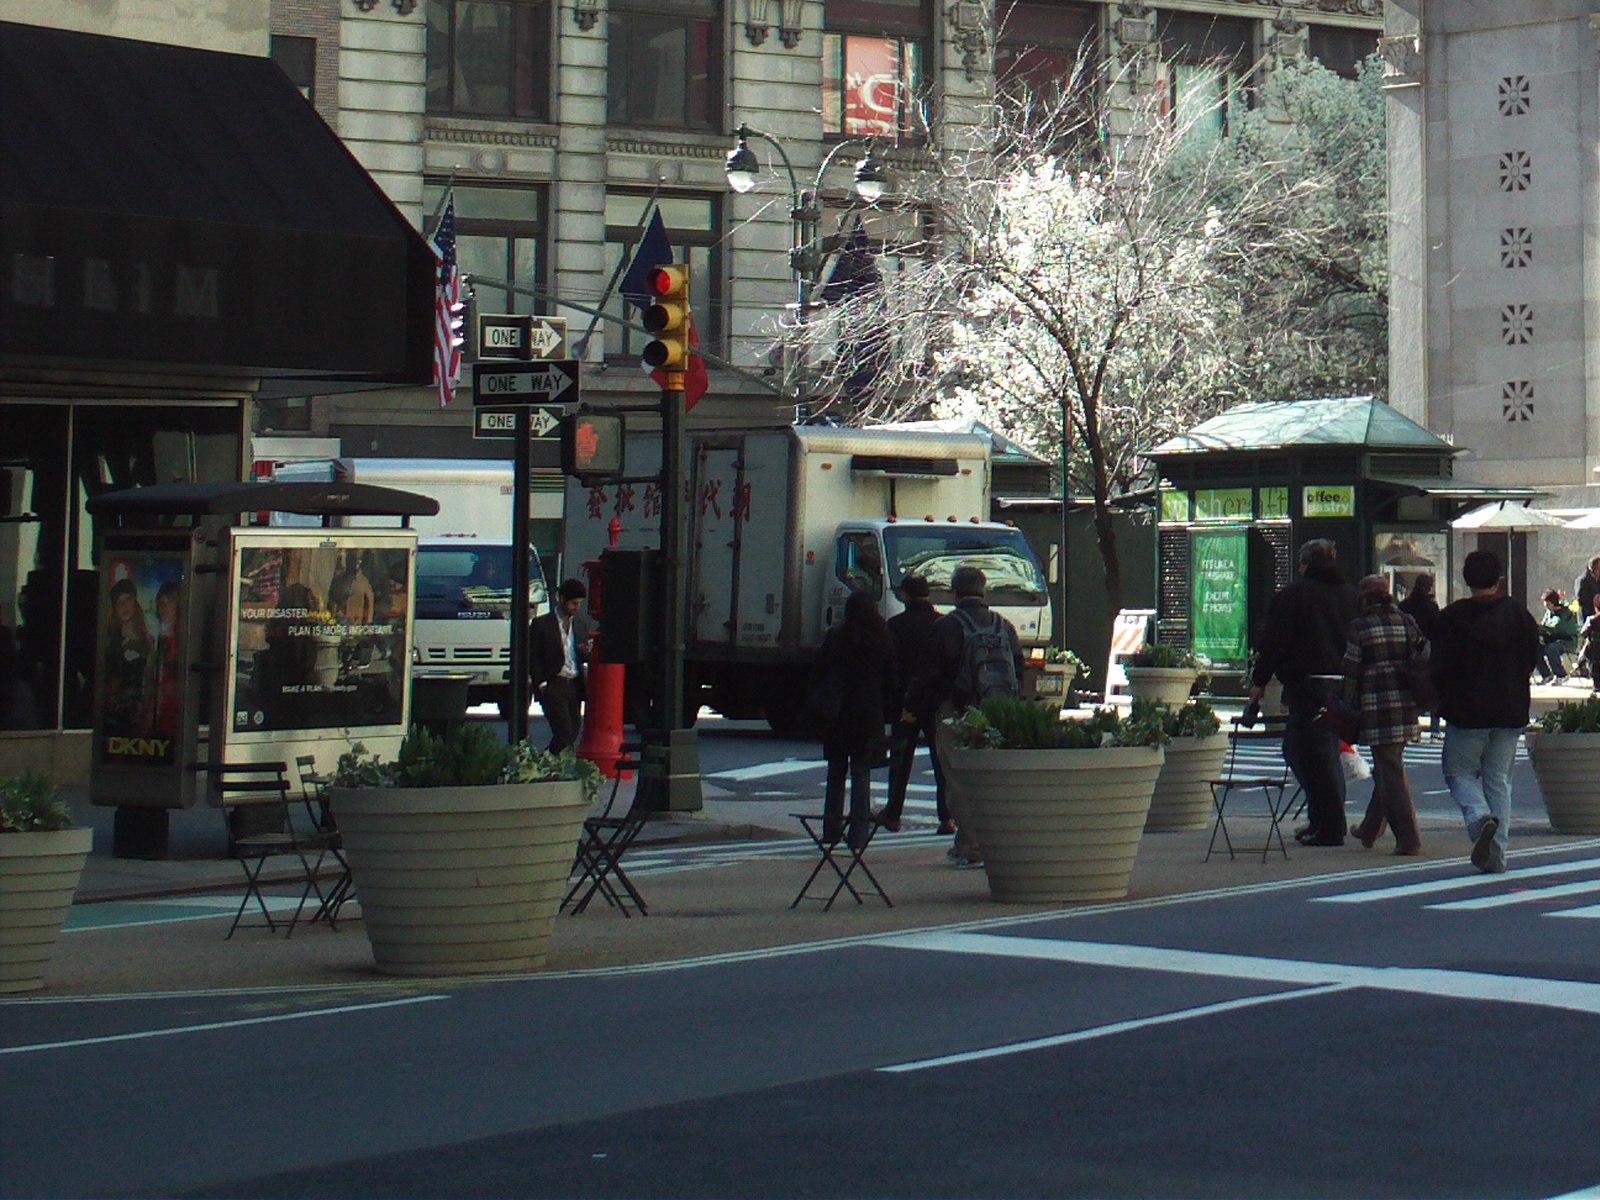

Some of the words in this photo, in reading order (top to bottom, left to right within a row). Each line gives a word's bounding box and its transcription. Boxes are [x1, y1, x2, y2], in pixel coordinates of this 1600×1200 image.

[492, 329, 517, 345] ONE
[487, 375, 518, 392] ONE
[531, 374, 562, 391] WAY
[487, 415, 514, 428] ONE
[531, 416, 551, 429] AY
[1308, 501, 1350, 514] pastry
[242, 607, 266, 619] YOUR
[266, 607, 309, 619] DISASTER
[457, 611, 491, 619] ISUZU
[288, 625, 311, 637] PLAN
[312, 625, 322, 636] IS
[322, 625, 348, 636] MORE
[108, 736, 170, 758] DKNY
